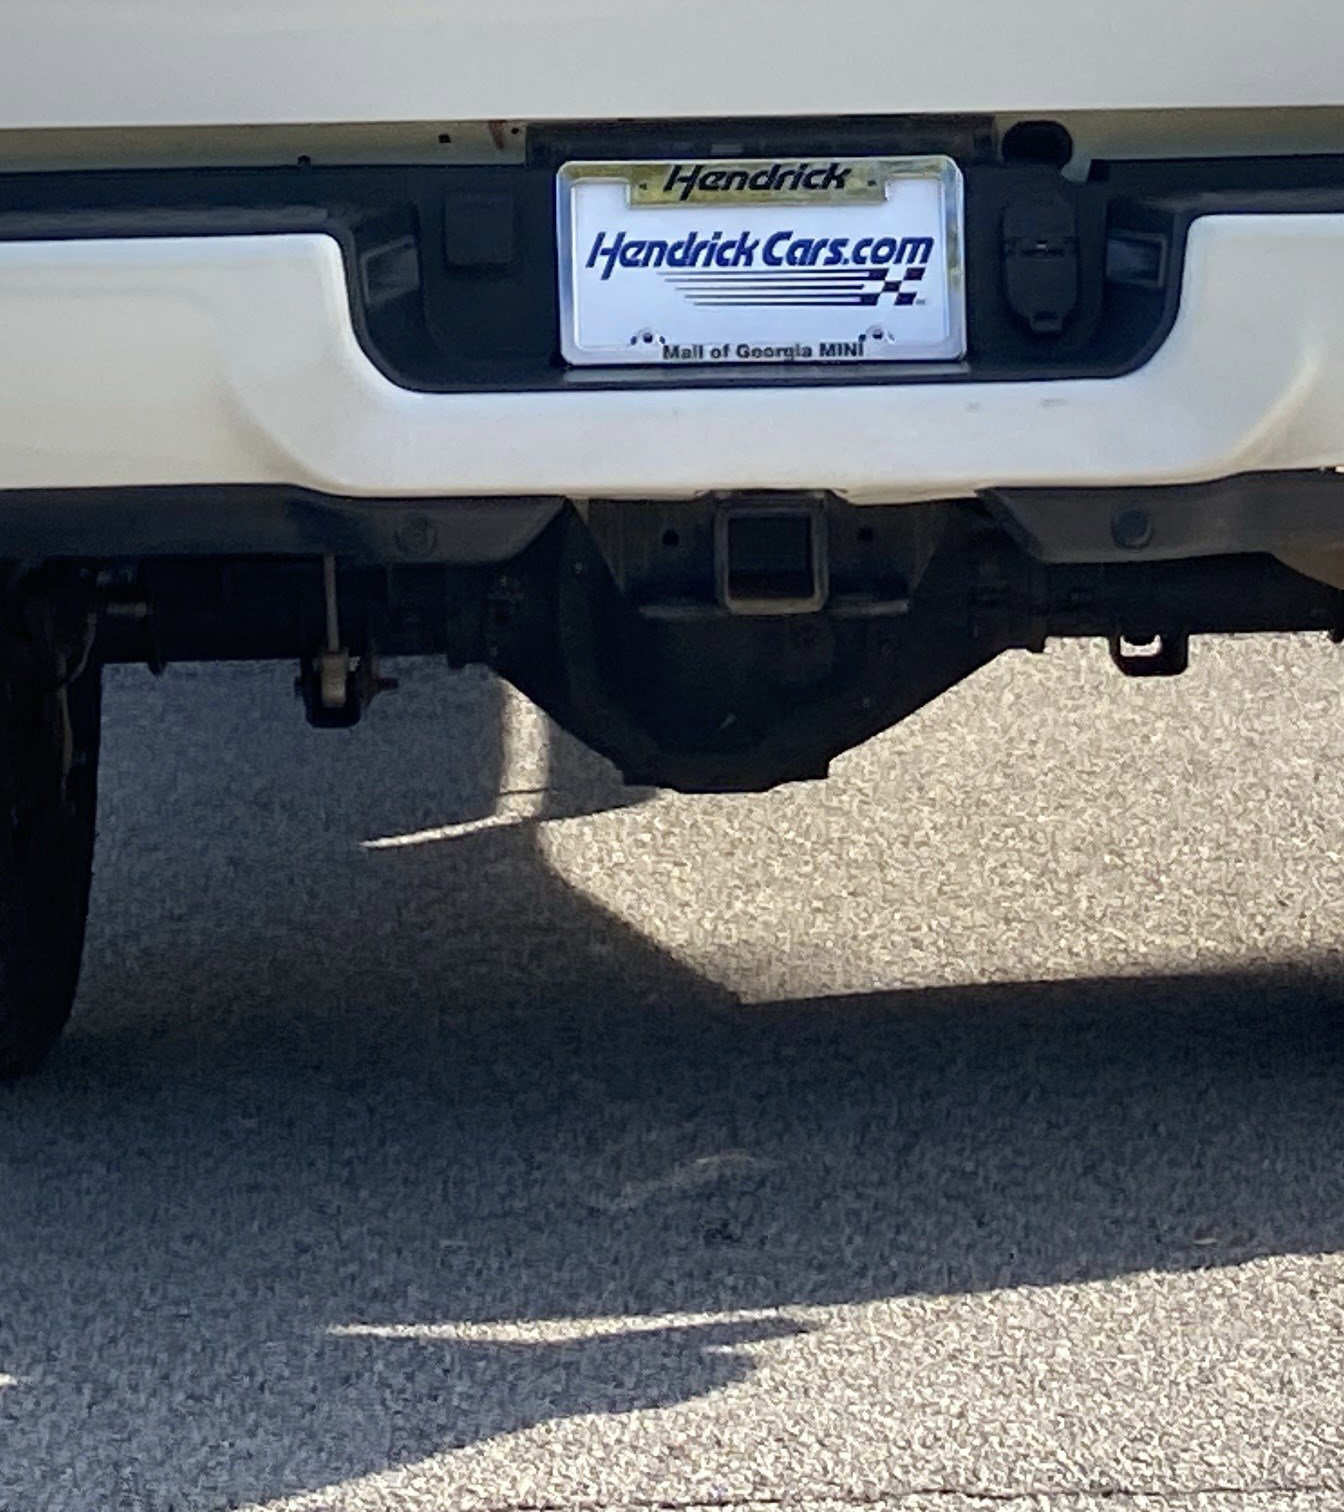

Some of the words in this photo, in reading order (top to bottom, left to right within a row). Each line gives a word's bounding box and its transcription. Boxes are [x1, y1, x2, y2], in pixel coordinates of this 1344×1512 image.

[663, 162, 852, 201] Hendrick
[662, 344, 704, 360] Mall
[709, 343, 731, 359] of
[735, 343, 813, 362] Georgia
[819, 341, 865, 357] MINI
